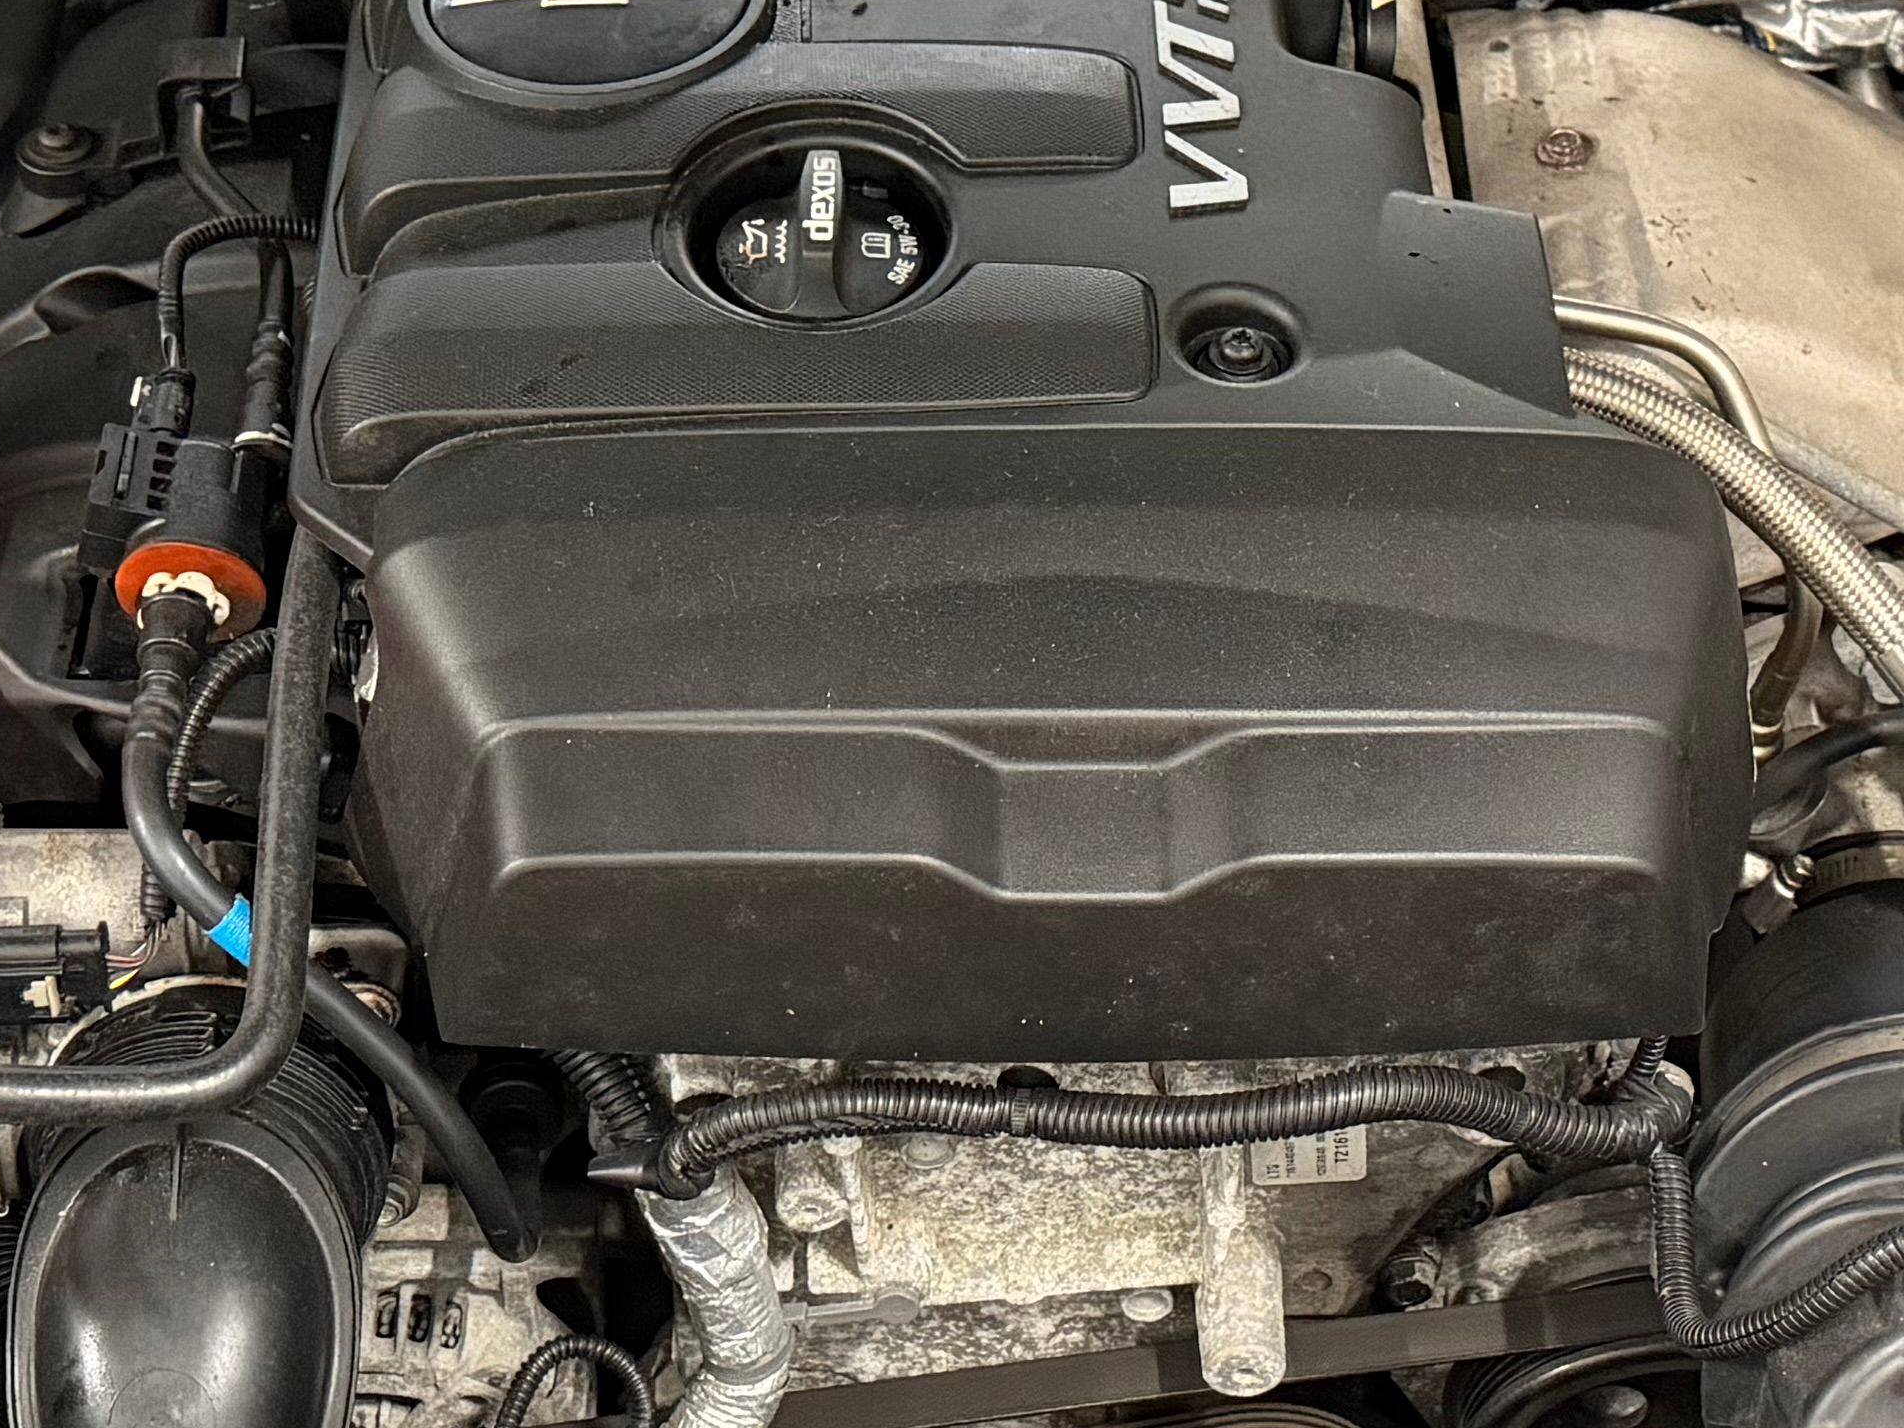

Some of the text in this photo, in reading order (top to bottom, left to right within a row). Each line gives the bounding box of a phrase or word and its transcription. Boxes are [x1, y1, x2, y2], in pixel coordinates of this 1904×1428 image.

[1153, 0, 1250, 212] VVT
[802, 156, 837, 241] dexos
[886, 214, 919, 285] SAE 5W-30
